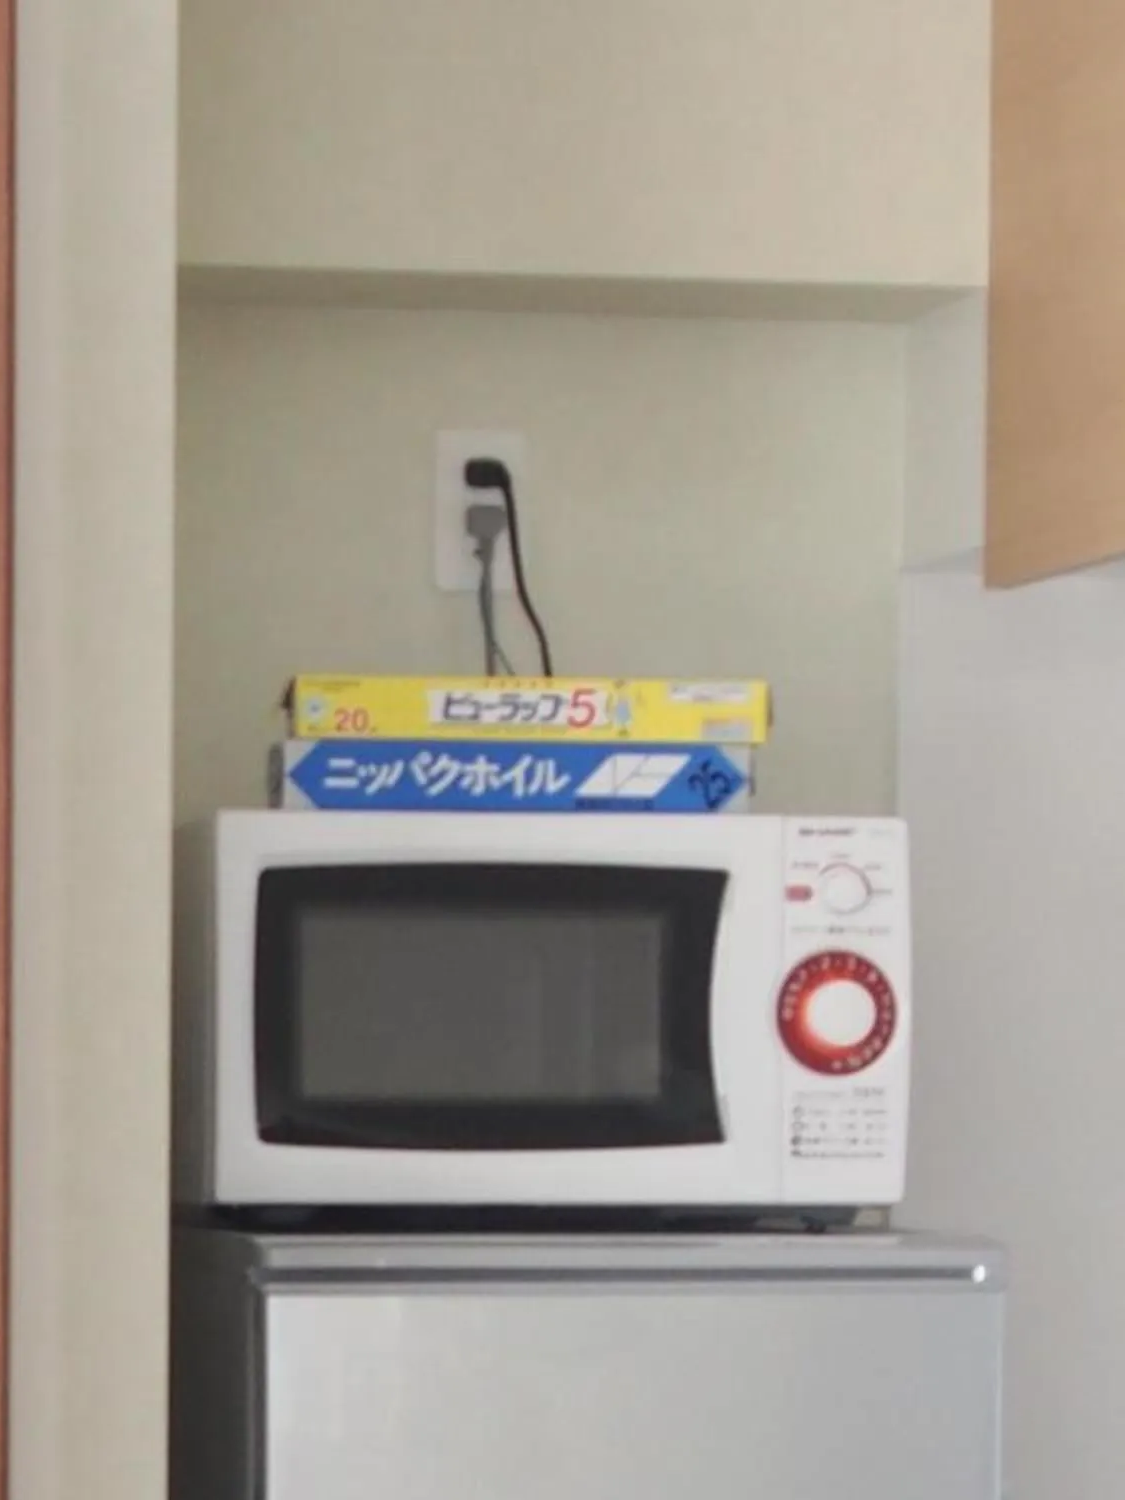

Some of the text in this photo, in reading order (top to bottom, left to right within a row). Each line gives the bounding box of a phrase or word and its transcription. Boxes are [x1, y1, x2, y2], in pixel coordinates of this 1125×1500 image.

[323, 751, 572, 797] ニッパクホイル
